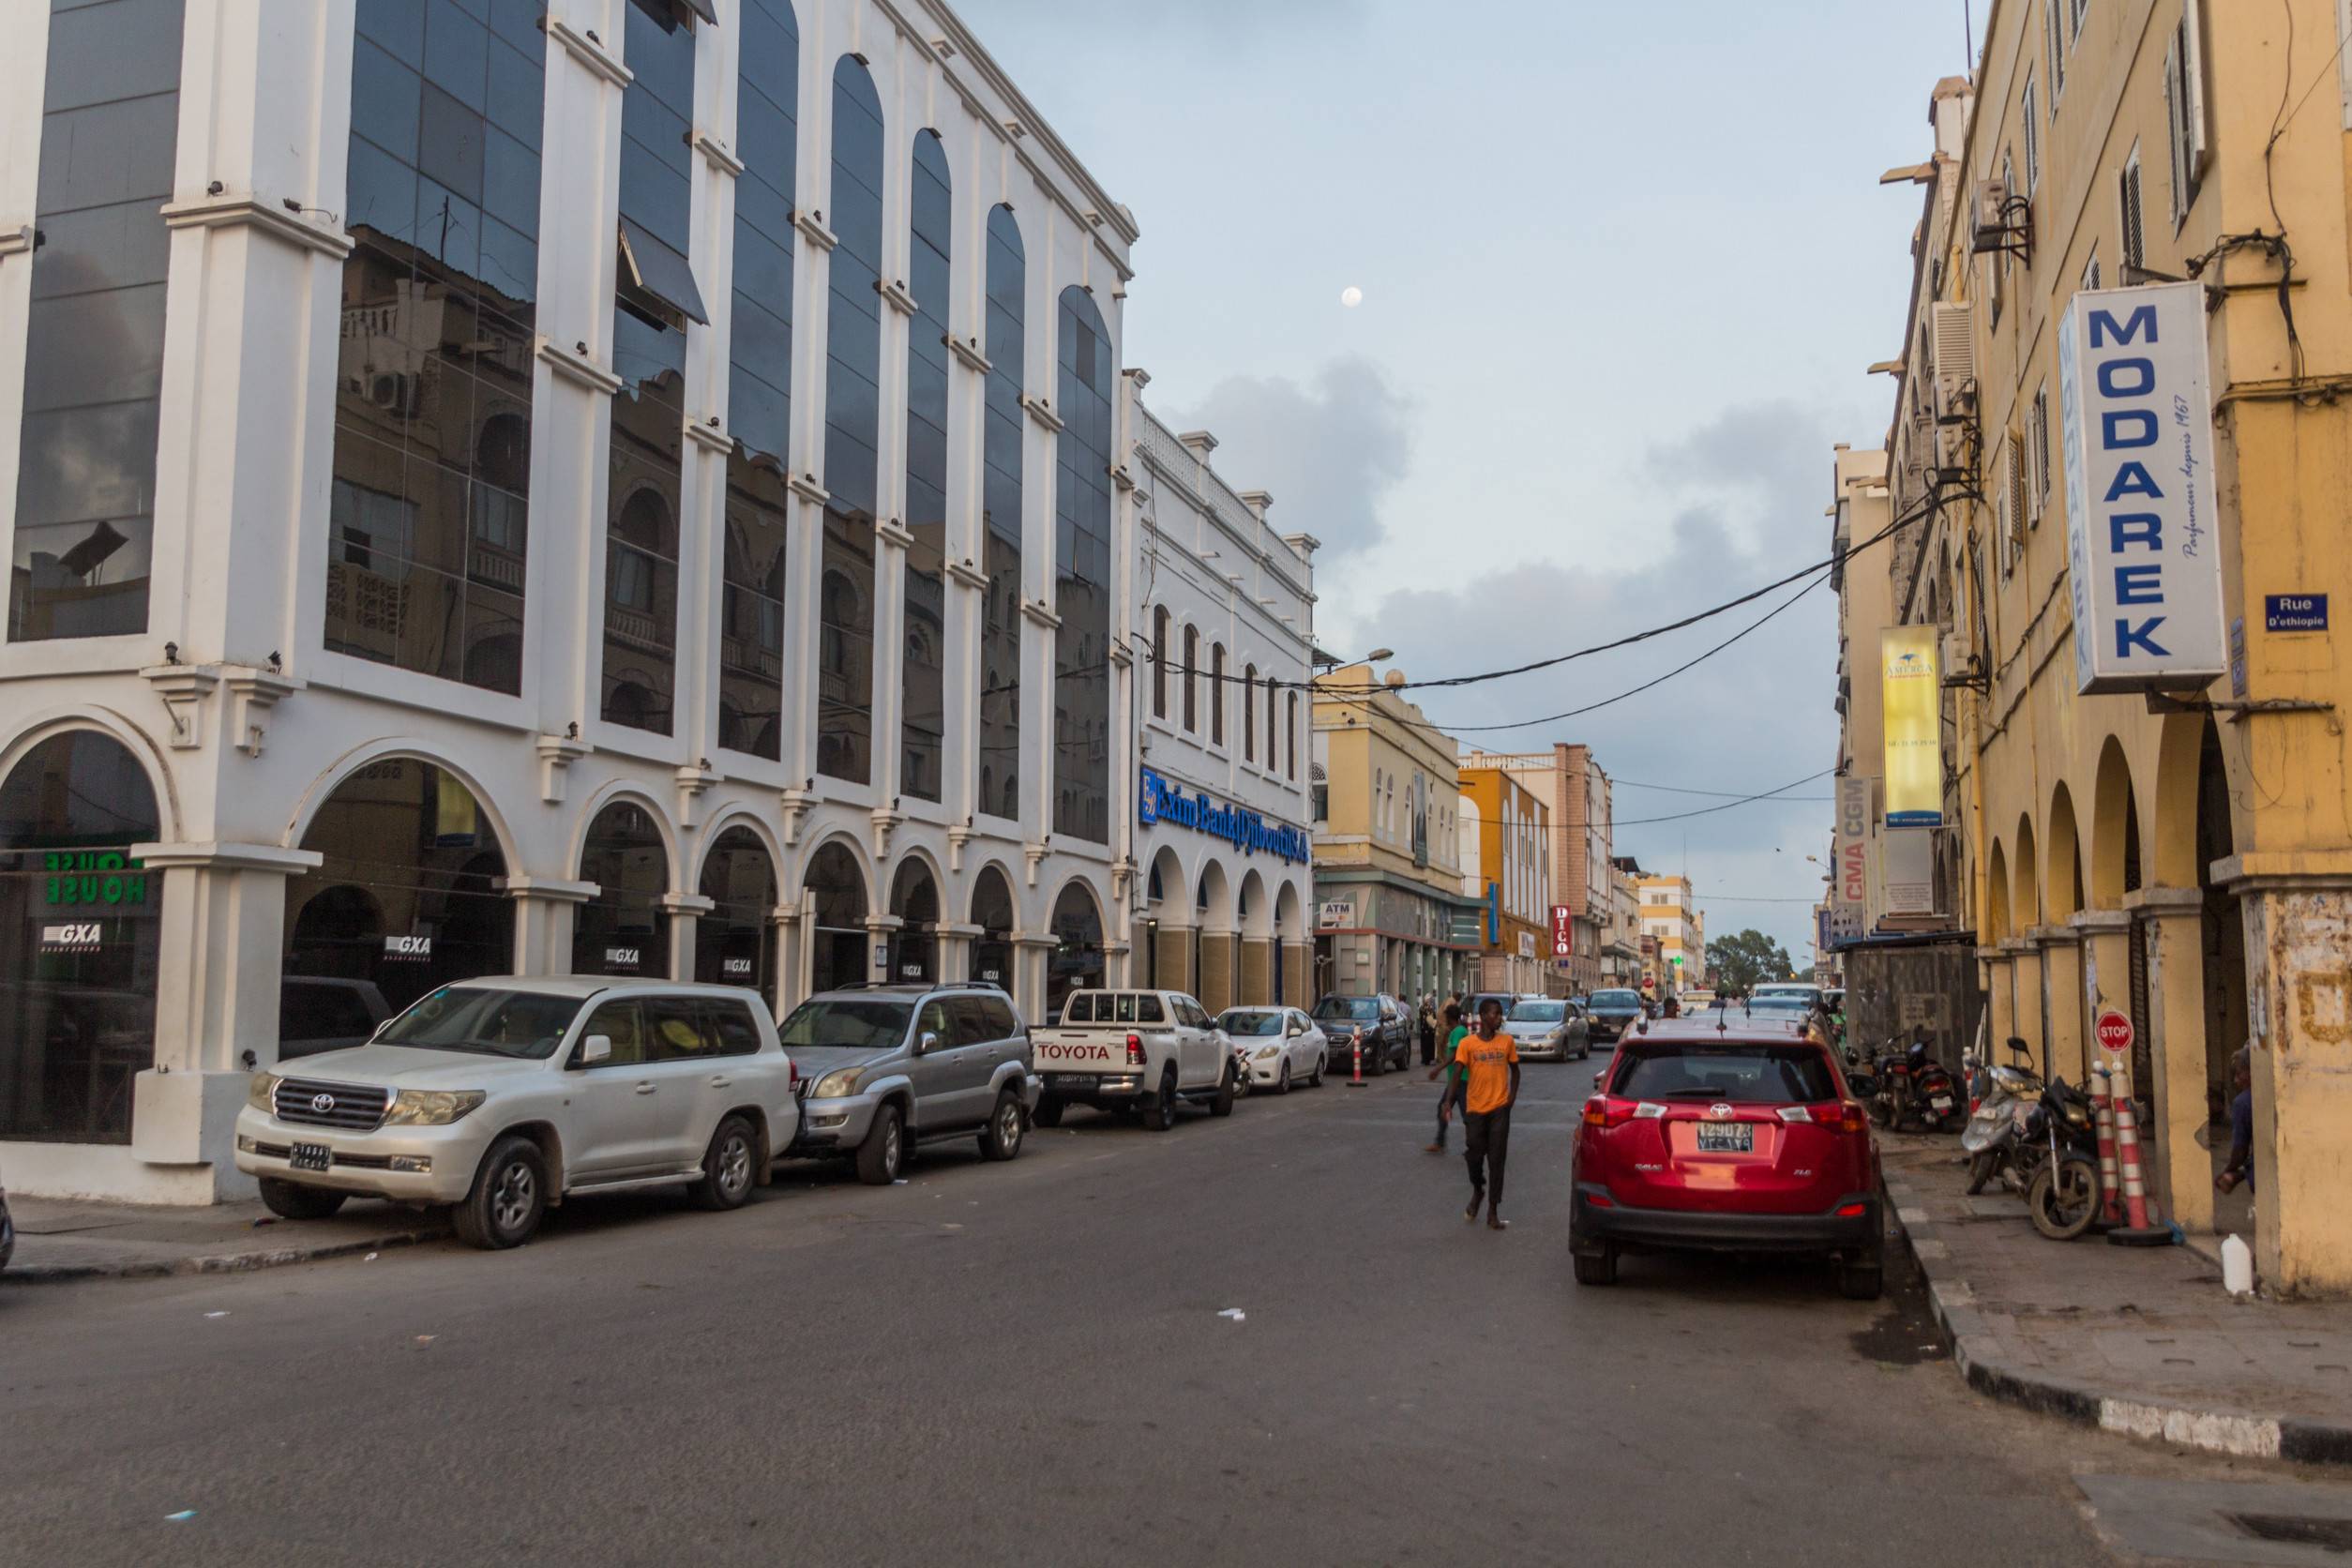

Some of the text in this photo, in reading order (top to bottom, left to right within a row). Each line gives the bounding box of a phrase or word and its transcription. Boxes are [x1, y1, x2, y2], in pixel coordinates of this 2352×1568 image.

[2174, 394, 2190, 428] 1967
[2179, 432, 2199, 478] depuis
[2088, 305, 2172, 658] MODAREK
[2280, 597, 2313, 611] Rue
[1157, 779, 1197, 827] Exim
[1198, 795, 1237, 842] Bank
[1845, 779, 1865, 900] CMA CGM
[1326, 903, 1349, 913] ATM
[59, 924, 101, 943] GXA
[1557, 908, 1568, 954] DICO
[399, 936, 431, 953] GXA
[615, 949, 640, 963] GXA
[731, 959, 751, 972] GXA
[2101, 1026, 2128, 1037] STOP
[1038, 1045, 1110, 1060] TOYOTA
